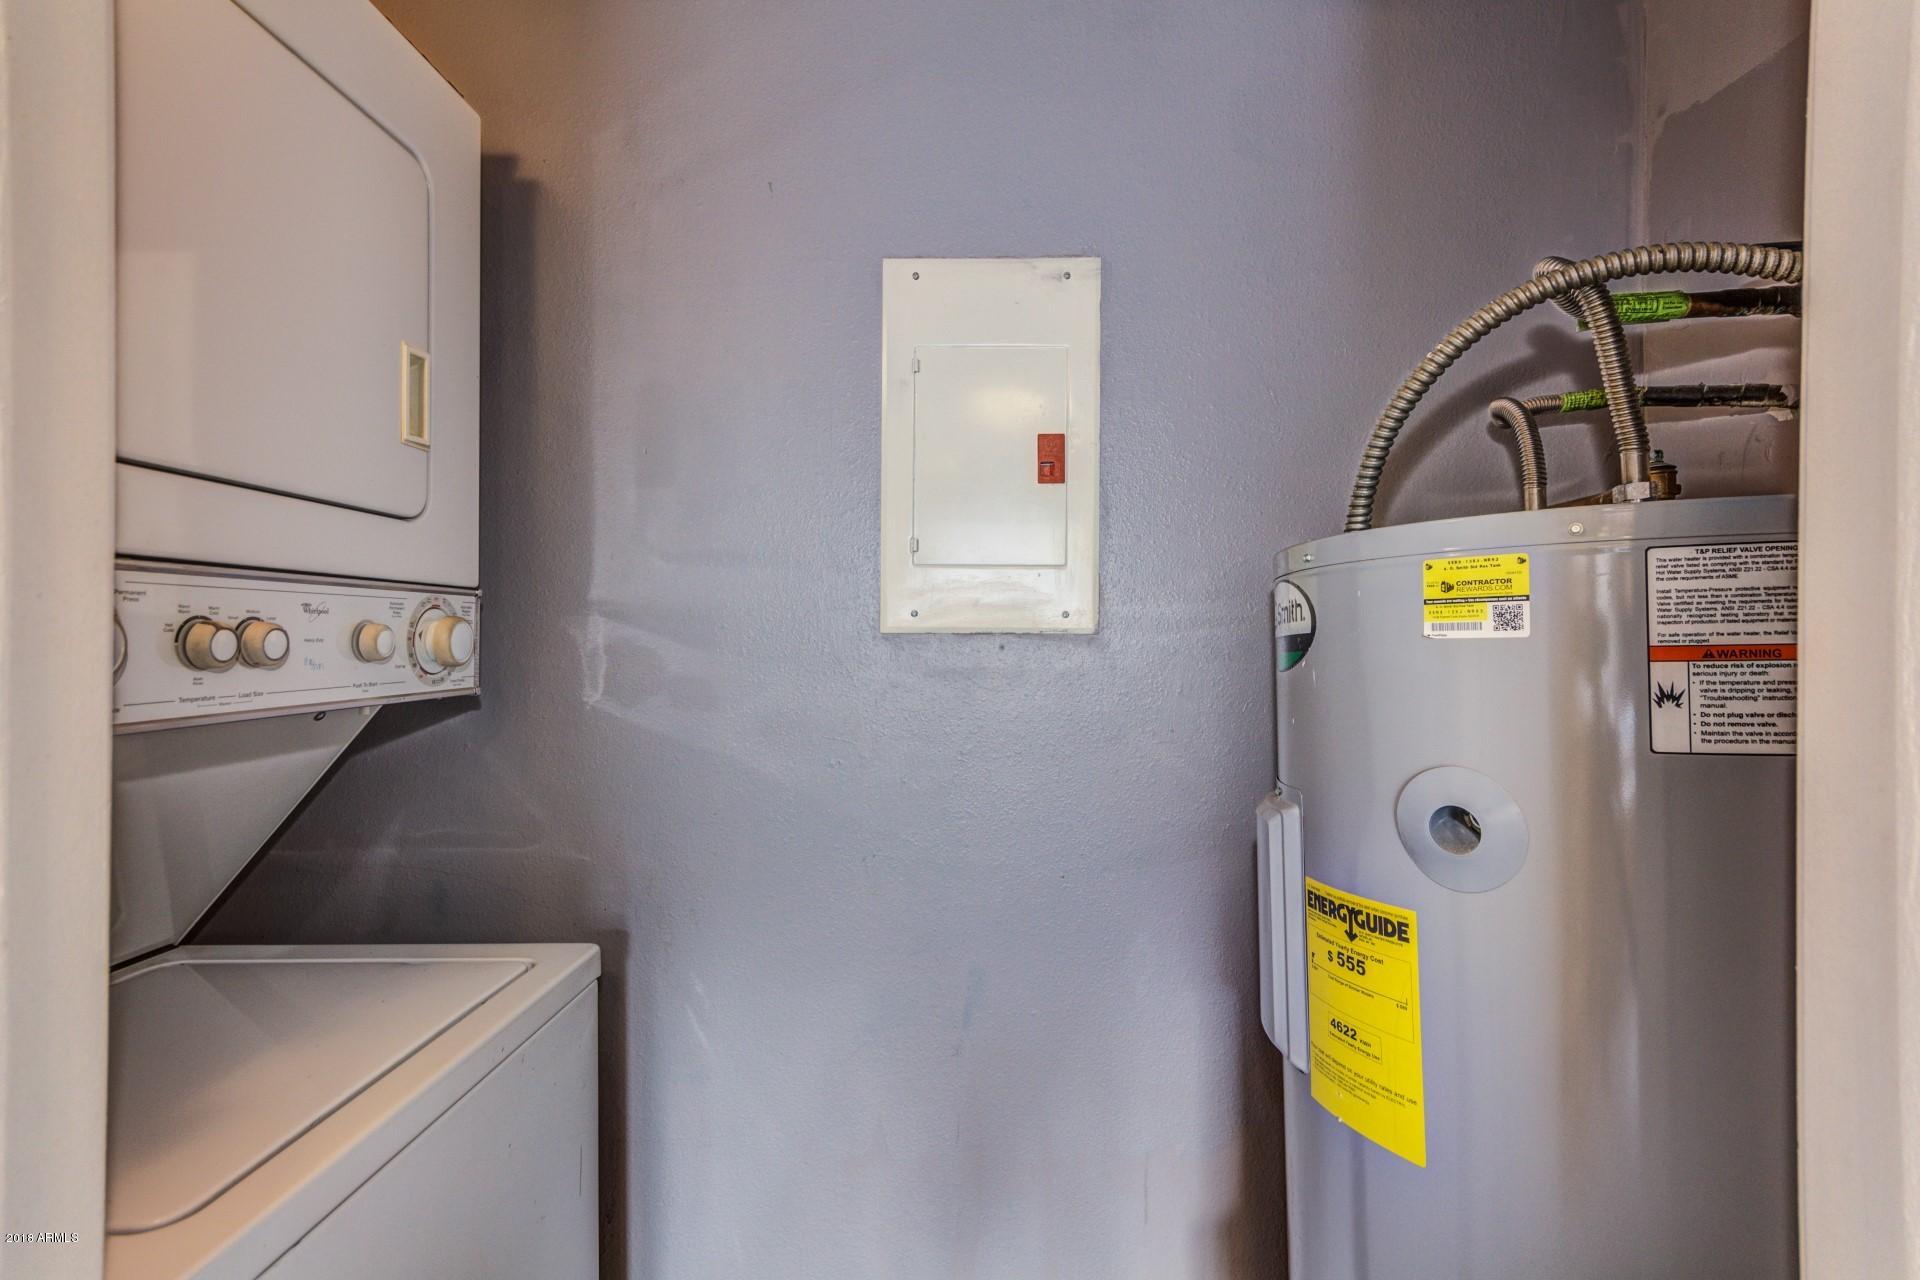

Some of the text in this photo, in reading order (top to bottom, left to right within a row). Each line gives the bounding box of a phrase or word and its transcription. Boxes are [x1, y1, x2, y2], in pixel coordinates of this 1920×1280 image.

[1456, 578, 1512, 586] CONTRACTOR
[303, 606, 329, 616] Whirlpool
[1716, 649, 1782, 658] WARNING
[1307, 890, 1410, 943] ENERGYGUIDE
[1337, 951, 1366, 976] 555
[1350, 948, 1369, 960] Energy
[1370, 955, 1384, 965] Cost
[1331, 1018, 1357, 1041] 4622
